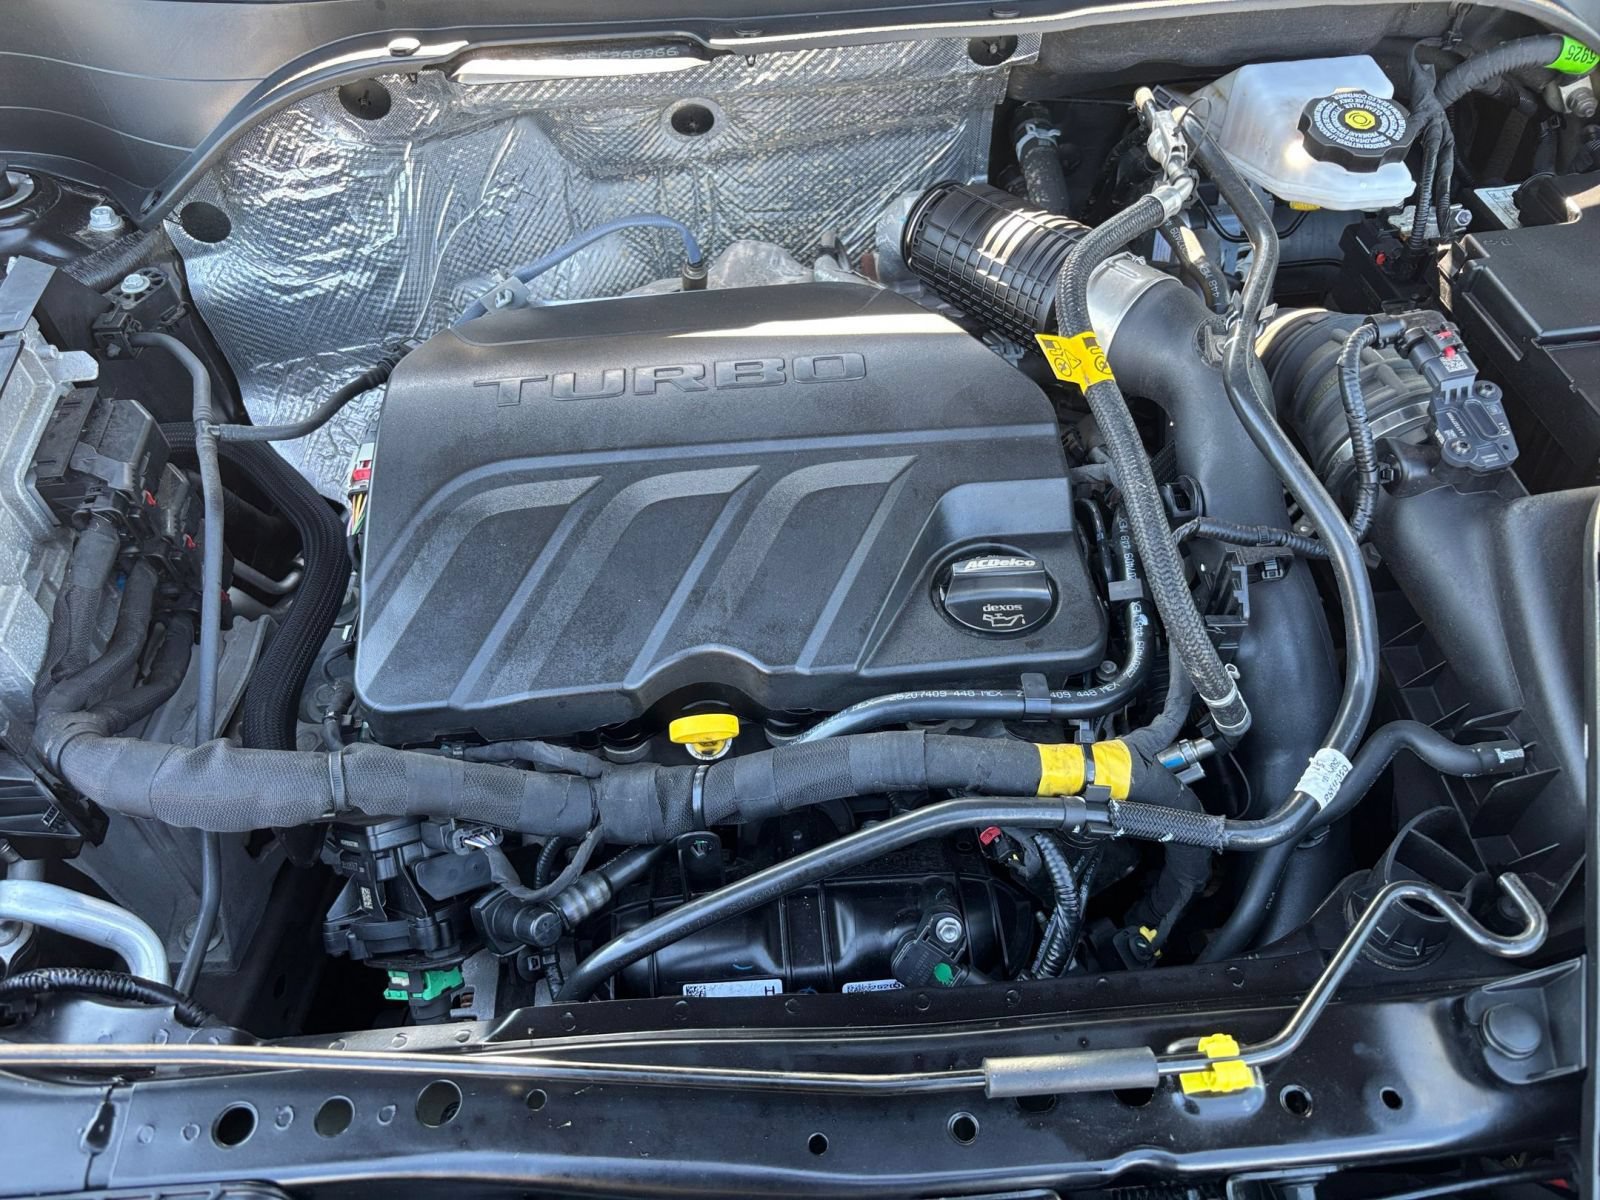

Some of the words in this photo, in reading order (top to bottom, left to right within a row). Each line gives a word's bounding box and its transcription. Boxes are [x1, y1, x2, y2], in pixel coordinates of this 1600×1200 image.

[473, 352, 868, 408] TURBO
[964, 558, 1036, 572] ACDelco
[982, 603, 1023, 612] dexos
[1077, 689, 1098, 698] 448
[1100, 681, 1121, 694] MEX
